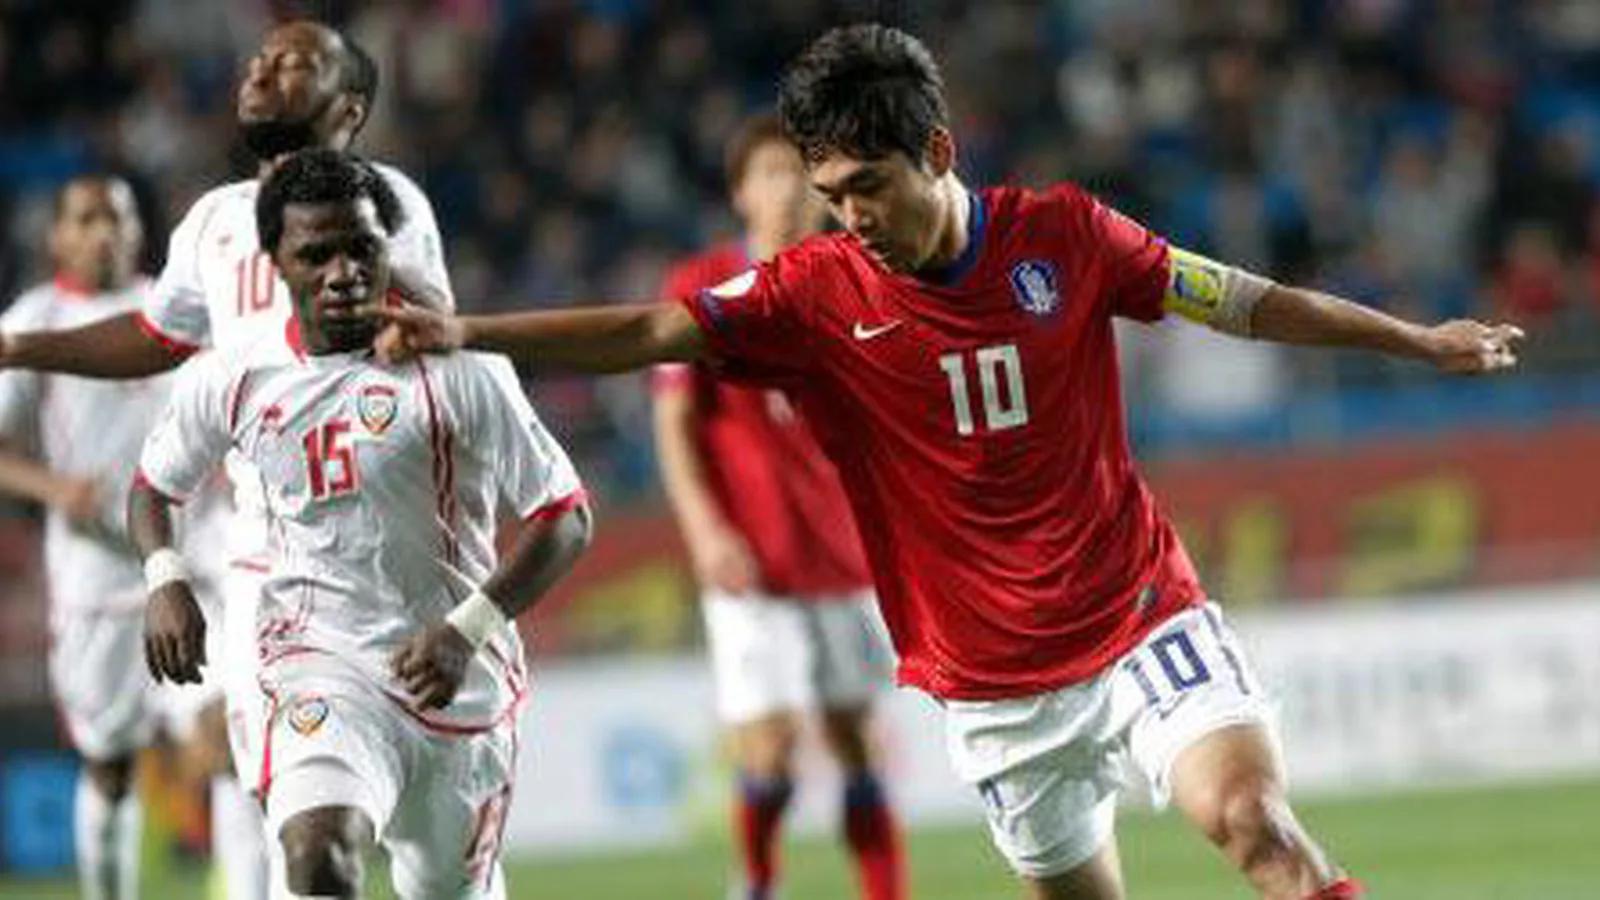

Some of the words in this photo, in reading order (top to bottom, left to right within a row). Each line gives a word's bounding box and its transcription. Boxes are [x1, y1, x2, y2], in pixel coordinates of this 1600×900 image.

[236, 252, 275, 317] 10
[939, 345, 1028, 436] 10
[303, 419, 356, 498] 15
[1122, 629, 1211, 706] 10
